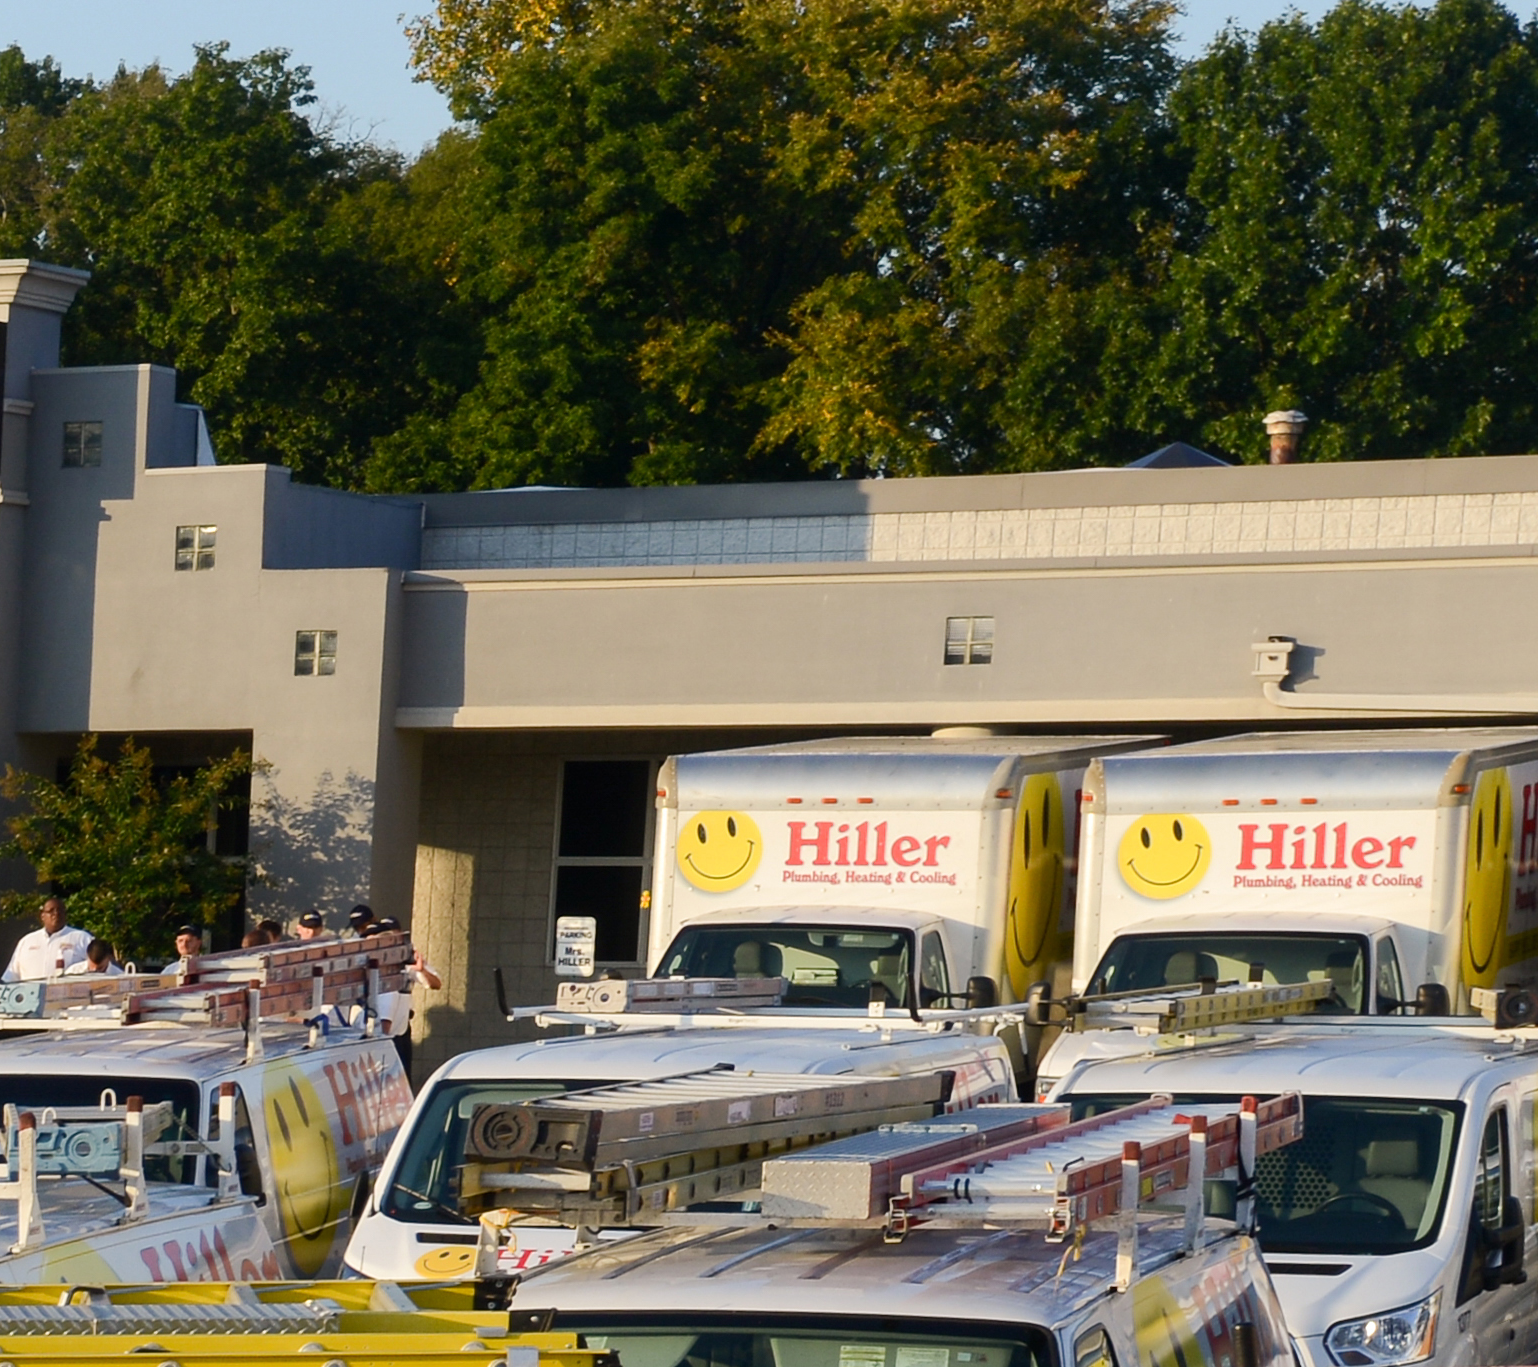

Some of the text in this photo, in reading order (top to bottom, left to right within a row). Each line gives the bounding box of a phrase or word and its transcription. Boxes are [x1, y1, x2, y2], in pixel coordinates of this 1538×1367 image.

[785, 821, 952, 868] Hiller
[1236, 822, 1417, 870] Hiller
[782, 870, 957, 886] Plumbing, Heating & Cooling
[1233, 874, 1423, 890] Plumbing, Heating & Cooling
[560, 931, 592, 939] PARKING
[565, 947, 586, 957] Mrs.
[558, 957, 591, 967] HILLER
